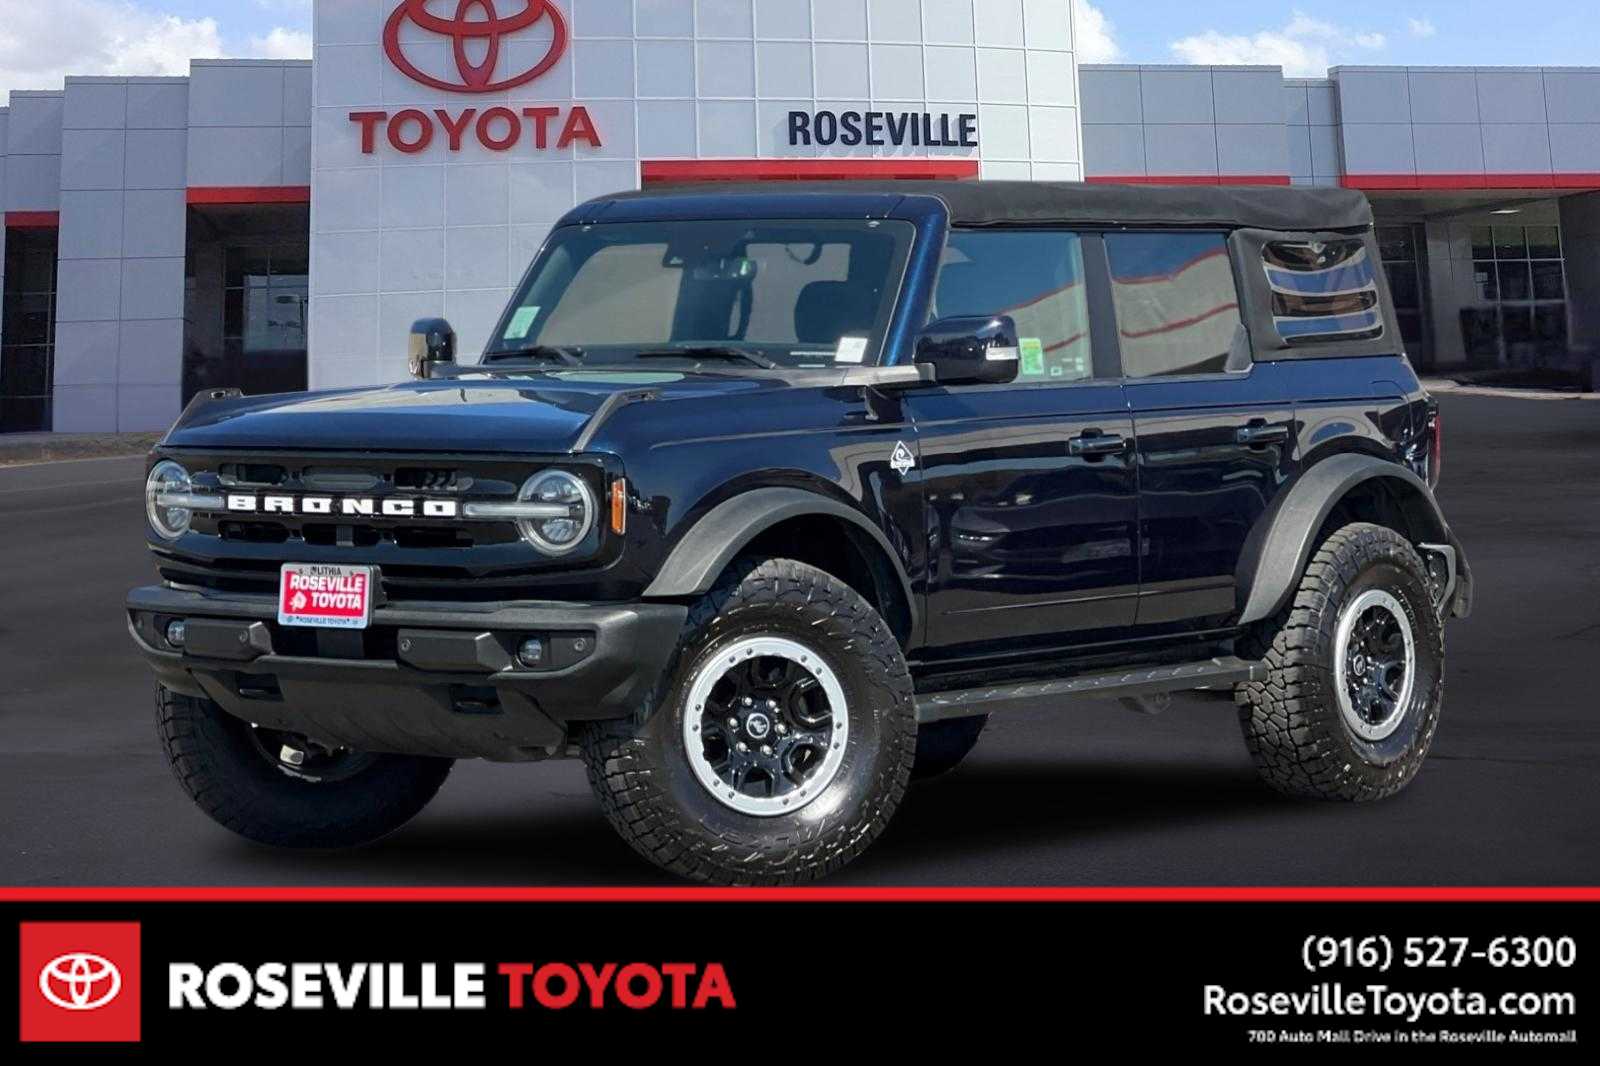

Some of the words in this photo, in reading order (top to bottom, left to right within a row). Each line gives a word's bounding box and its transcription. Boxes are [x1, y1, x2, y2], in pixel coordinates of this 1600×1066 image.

[349, 105, 602, 154] TOYOTA
[788, 111, 978, 147] ROSEVILLE
[227, 495, 457, 517] BRONCO
[290, 574, 364, 592] ROSEVILLE
[311, 592, 361, 610] TOYOTA
